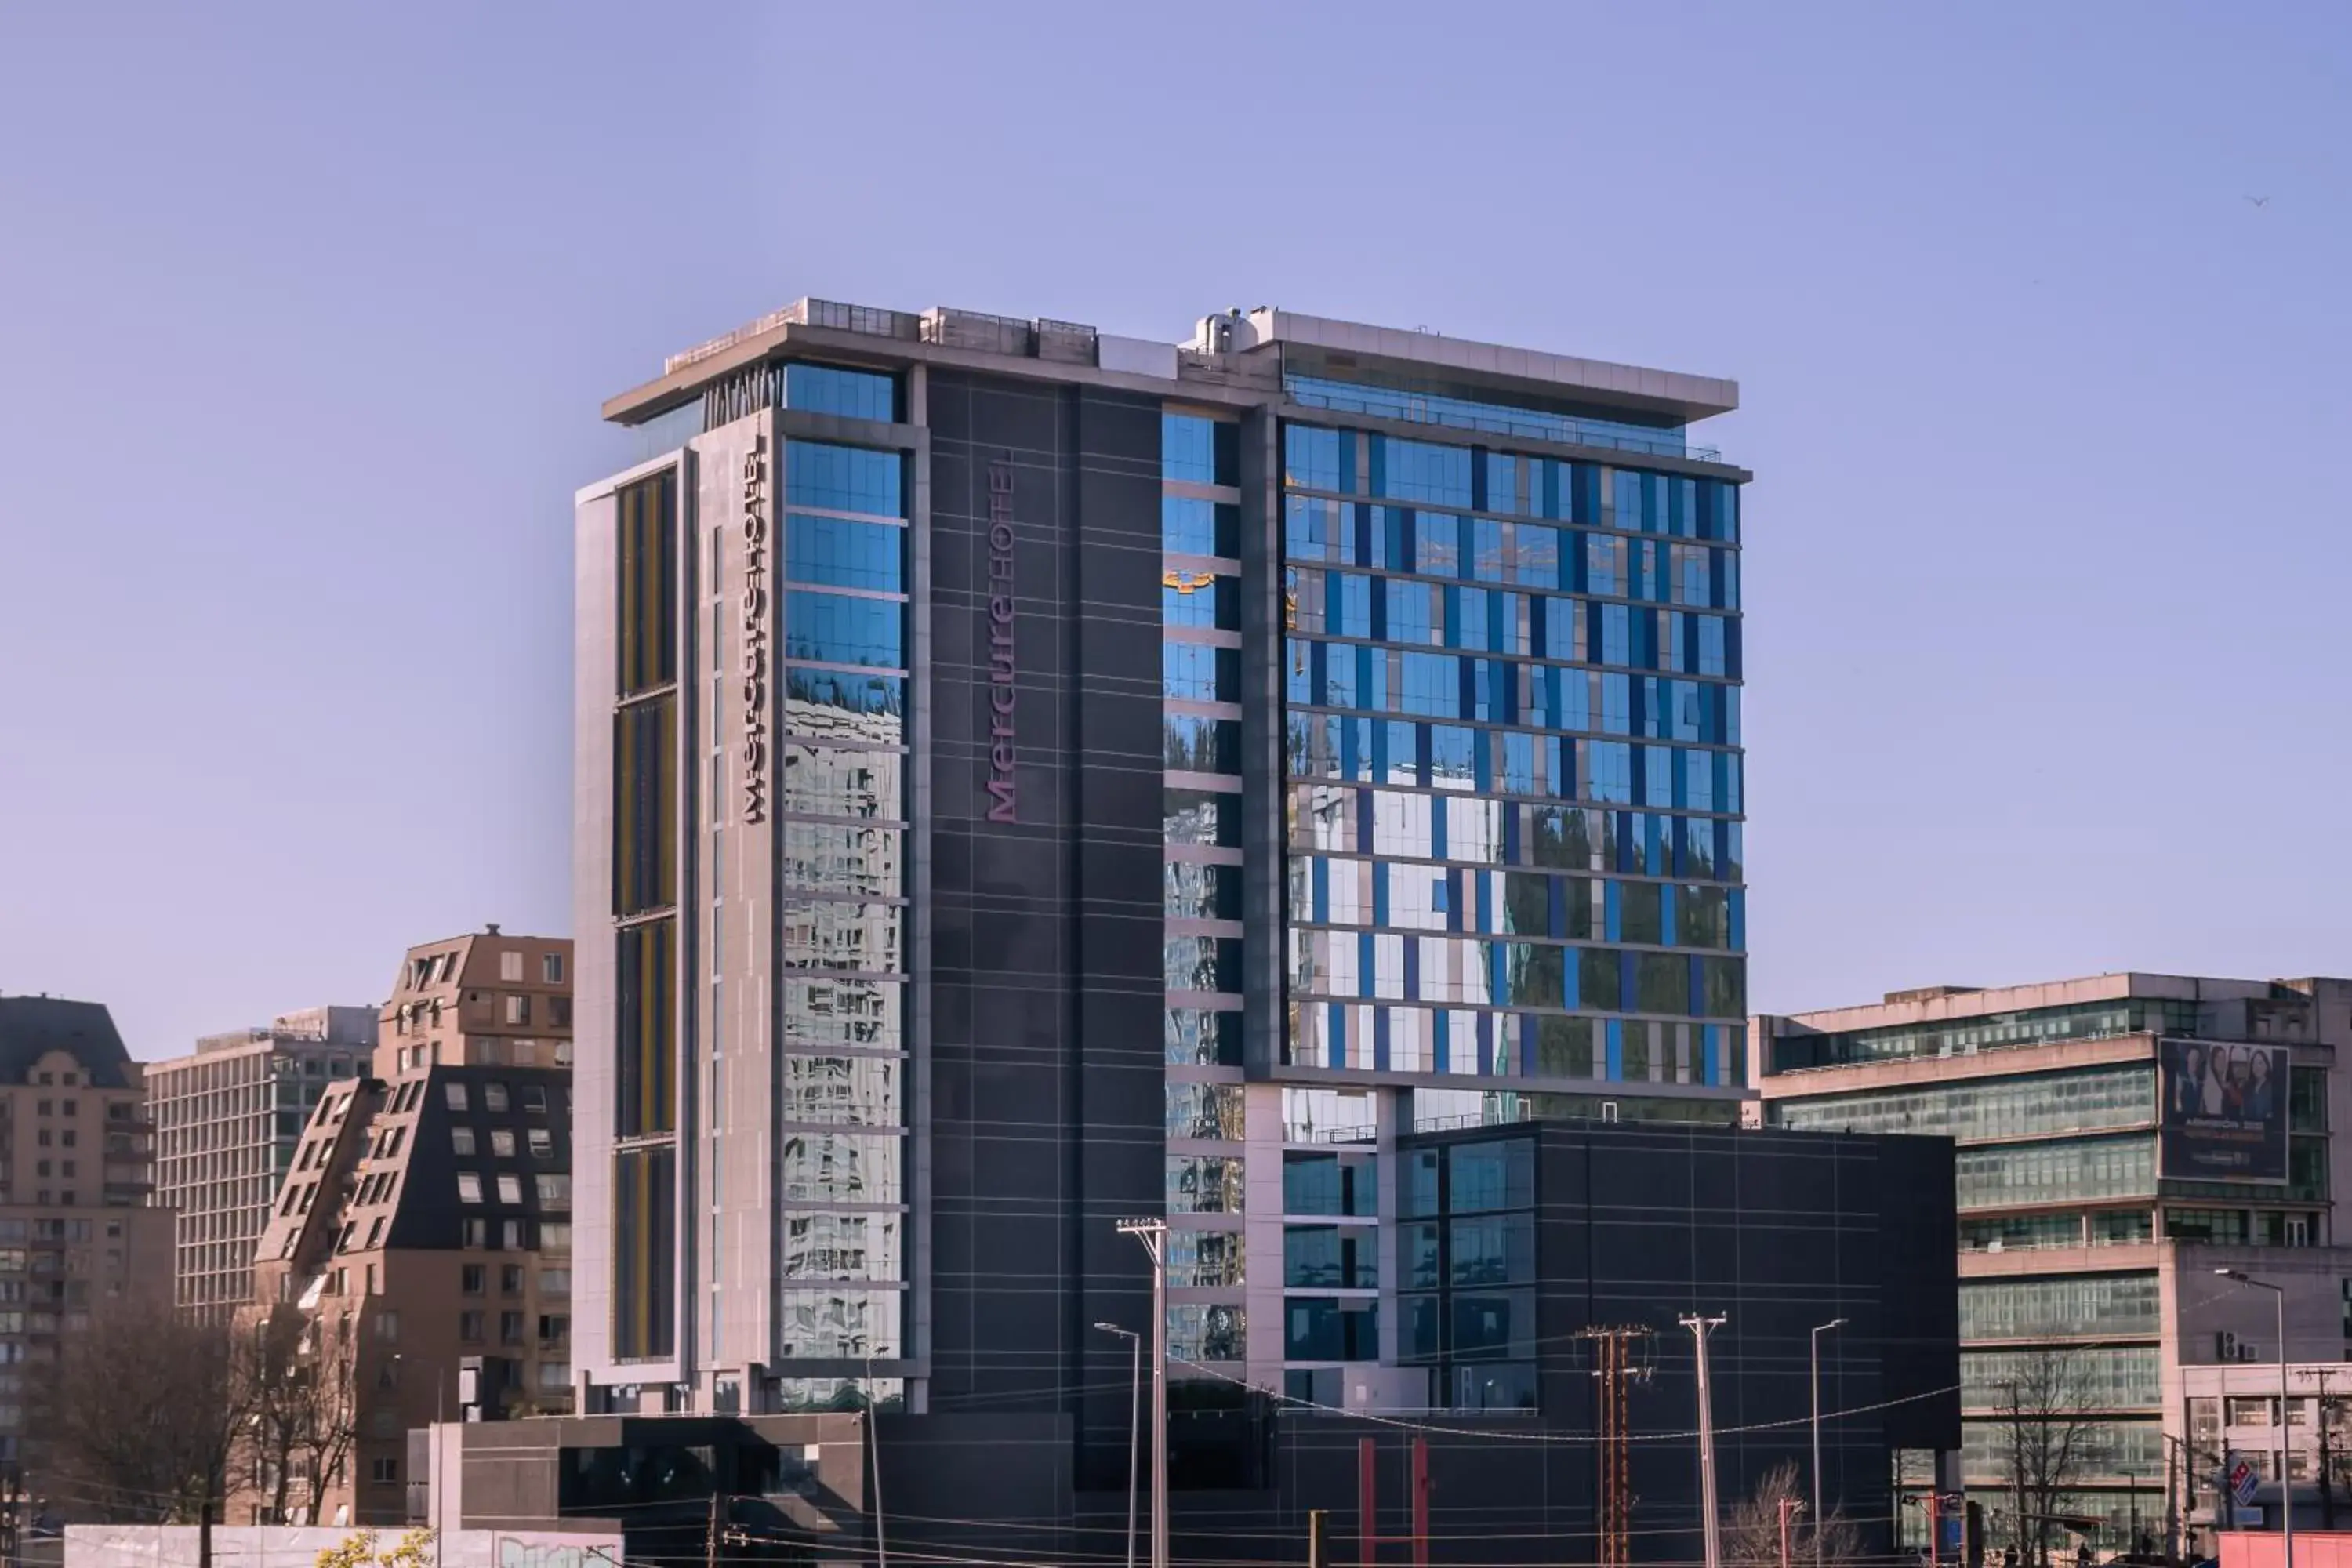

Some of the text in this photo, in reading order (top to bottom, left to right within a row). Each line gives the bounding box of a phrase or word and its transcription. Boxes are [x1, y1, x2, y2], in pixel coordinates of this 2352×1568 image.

[744, 435, 765, 824] Mercure HOTEL
[988, 449, 1016, 823] Mercure HOTEL
